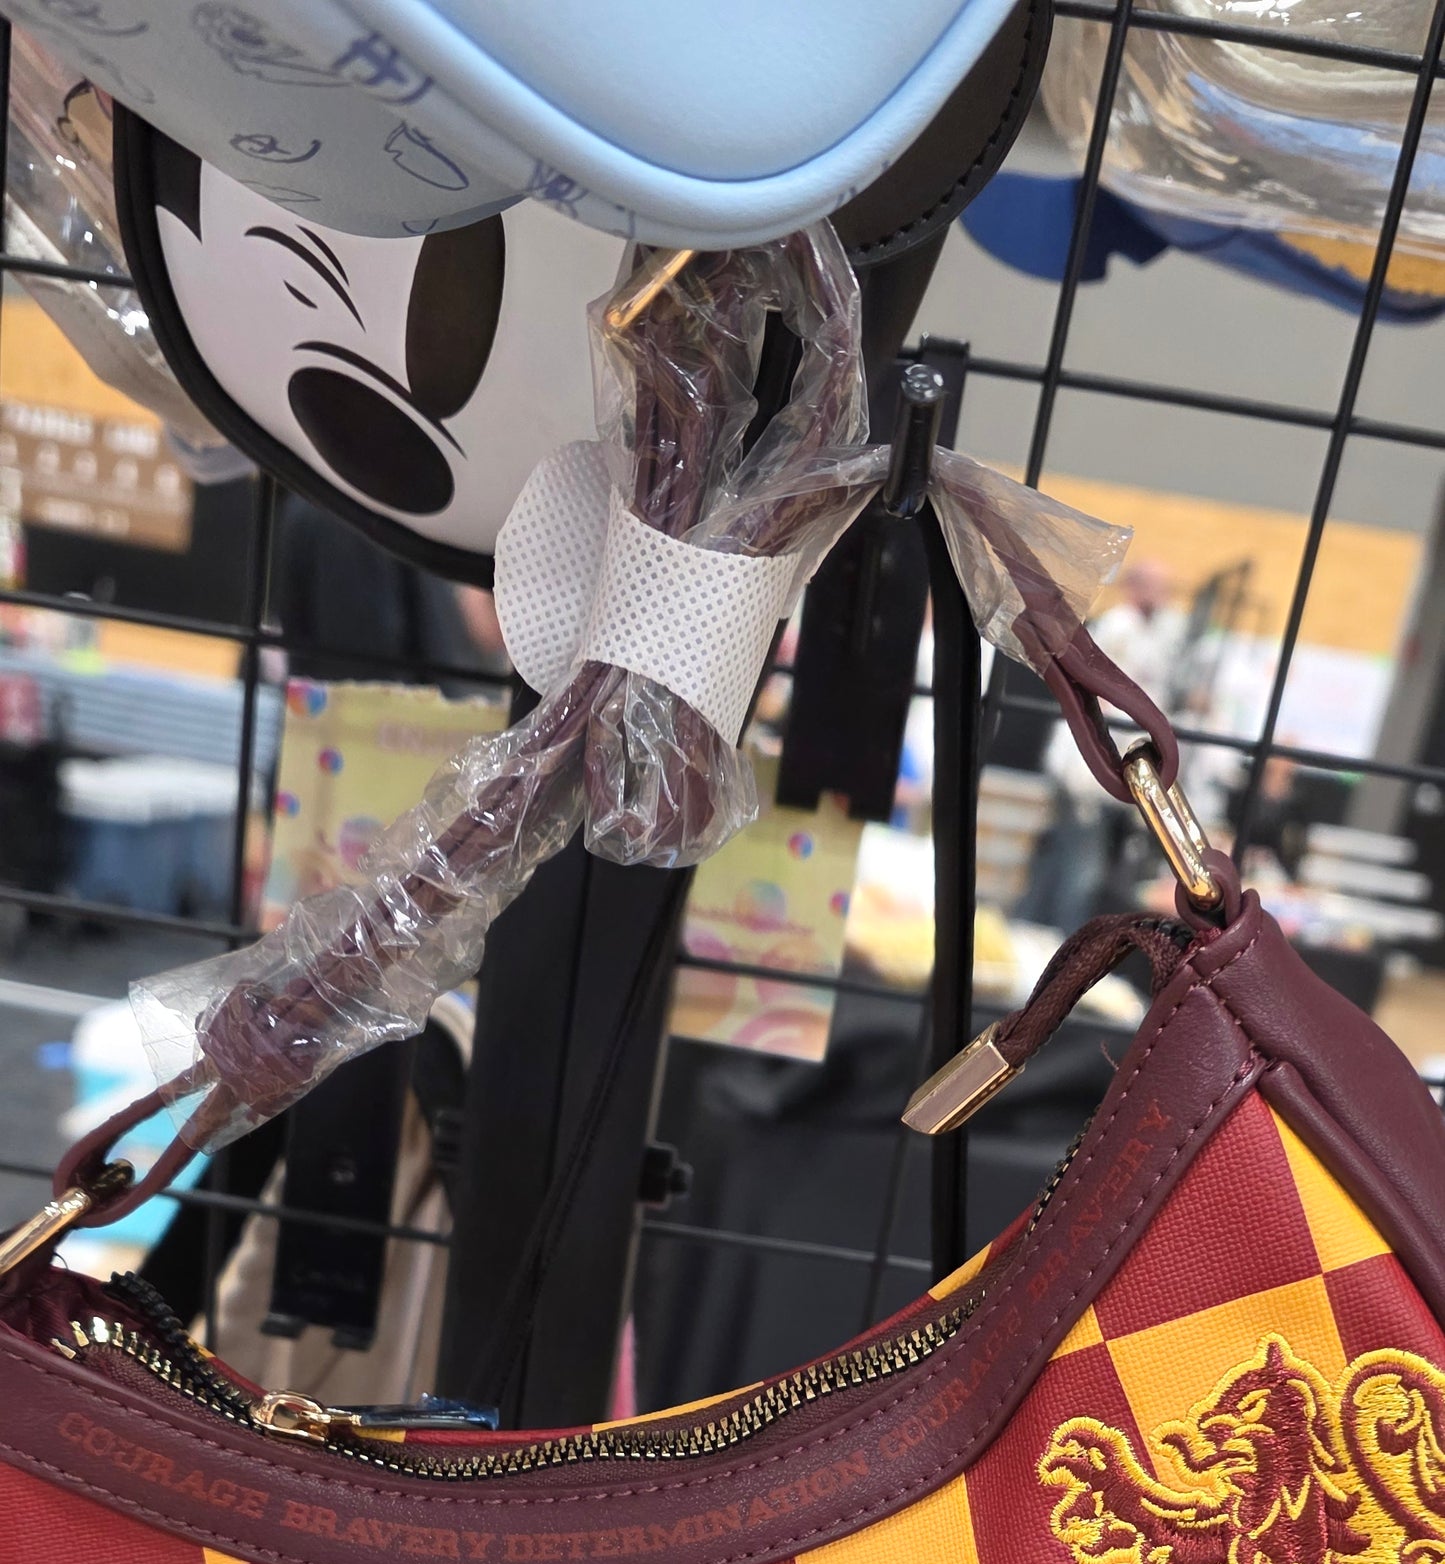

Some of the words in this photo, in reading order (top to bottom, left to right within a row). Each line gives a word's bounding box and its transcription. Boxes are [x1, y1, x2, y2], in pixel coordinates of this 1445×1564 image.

[57, 1411, 270, 1520] COURAGE
[280, 1499, 497, 1560] BRAVERY
[502, 1450, 870, 1562] DETERMINATION
[1026, 1098, 1174, 1300] BRAVERY
